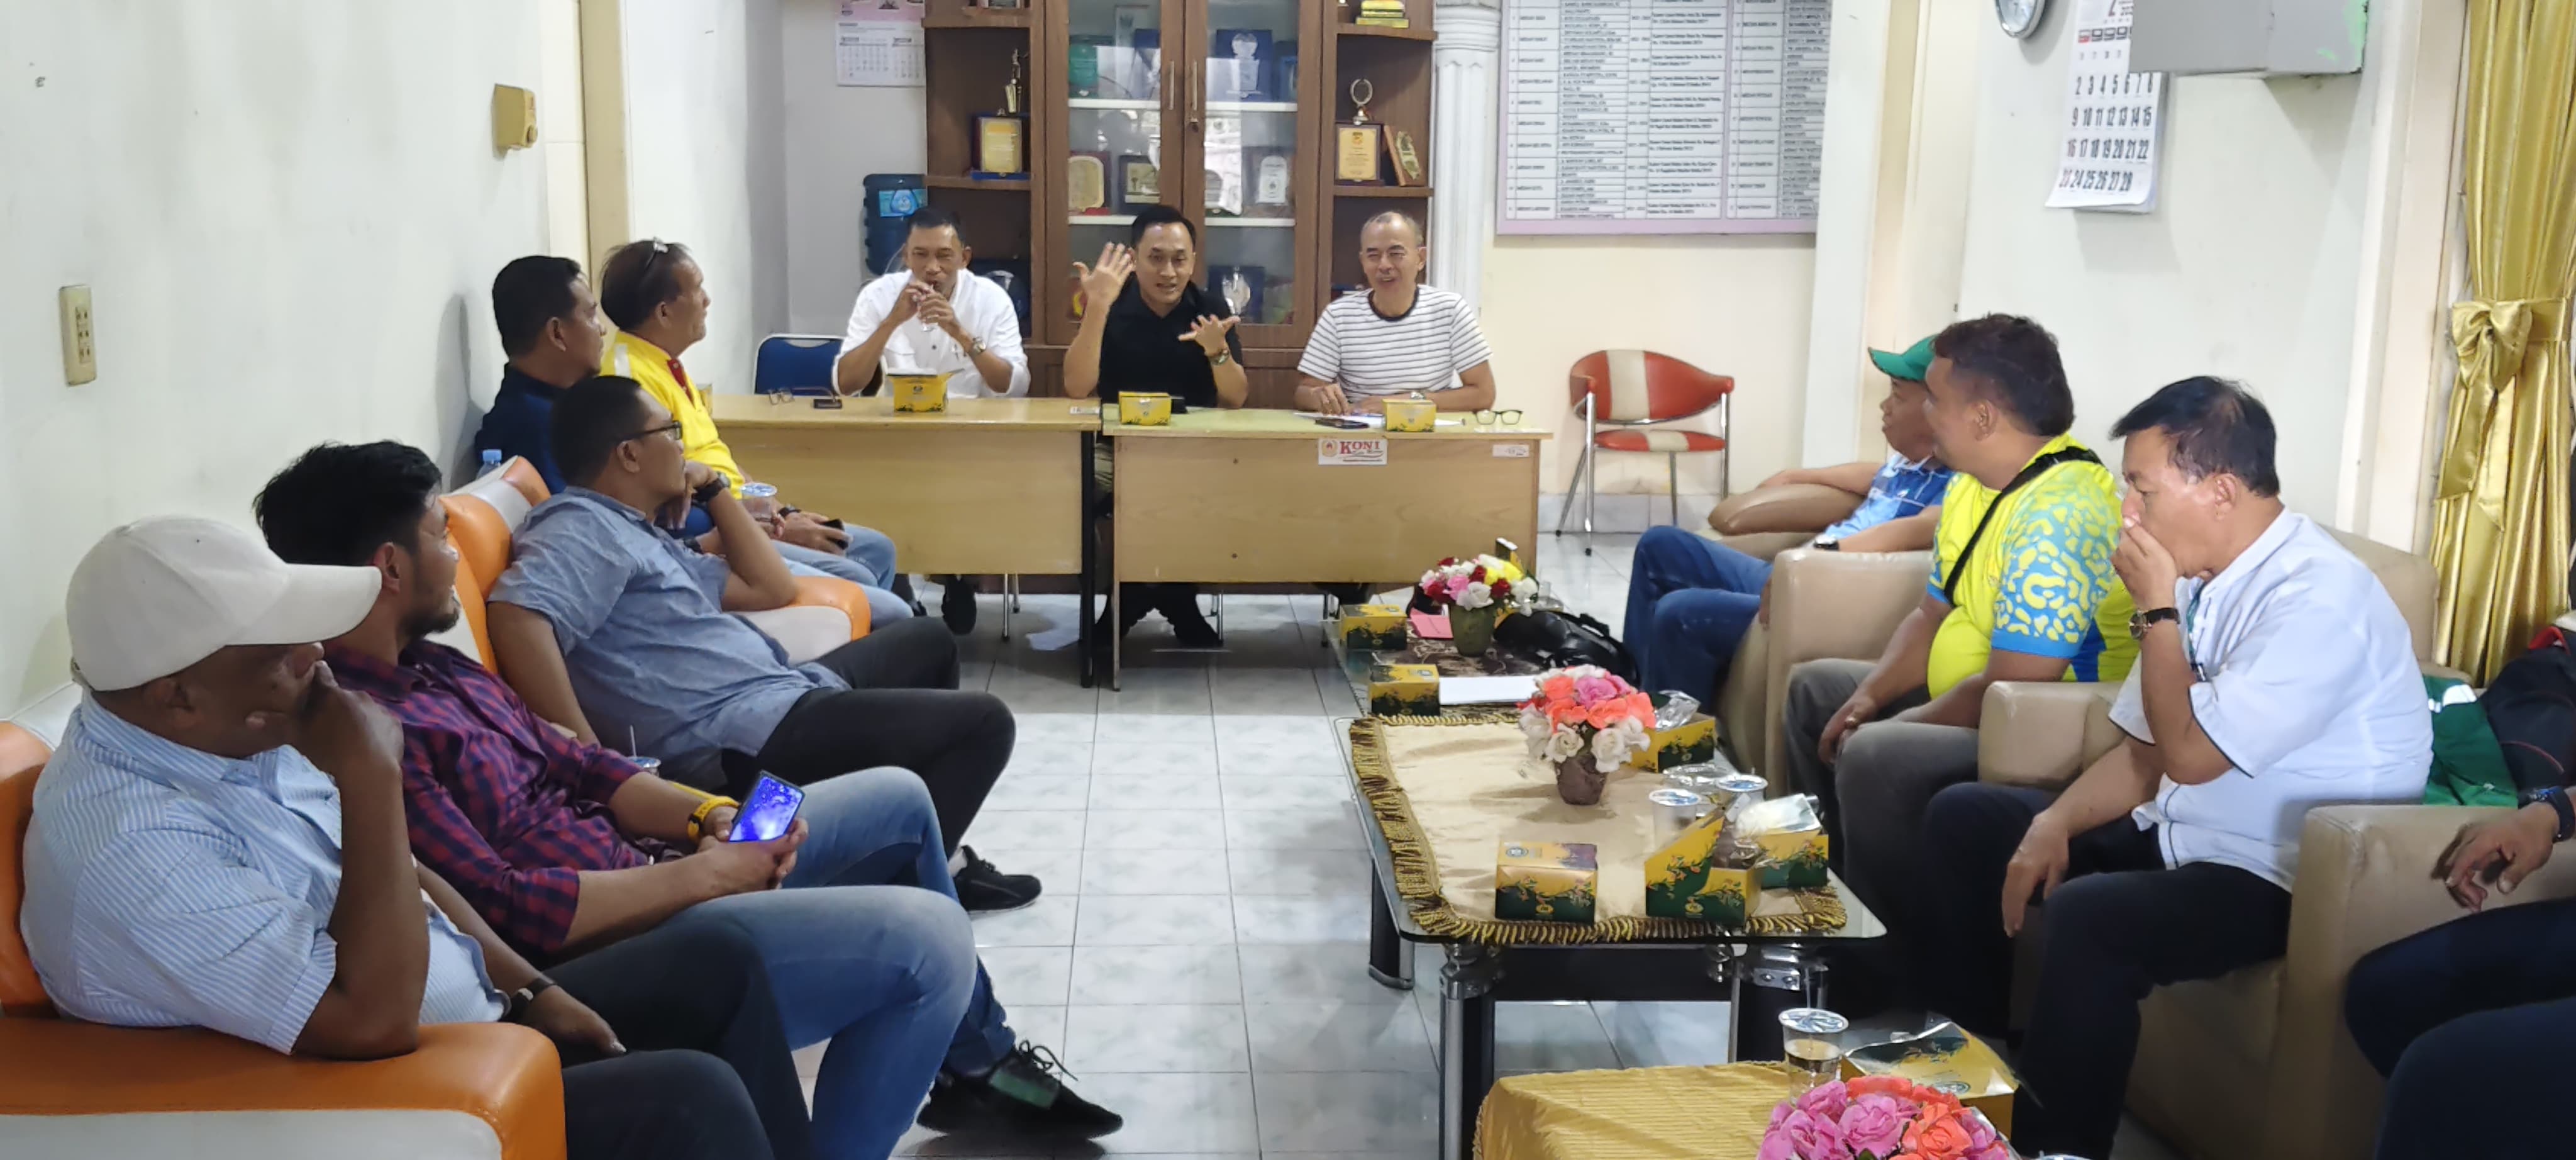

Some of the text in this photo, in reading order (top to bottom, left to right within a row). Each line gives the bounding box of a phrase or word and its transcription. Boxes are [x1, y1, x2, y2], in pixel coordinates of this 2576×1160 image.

[2075, 76, 2082, 95] 2
[2088, 75, 2094, 95] 3
[2100, 75, 2106, 94] 4
[2112, 74, 2118, 94] 5
[2124, 74, 2130, 94] 6
[2072, 106, 2152, 126] 9 10 11 12 13 14 15
[2067, 138, 2149, 159] 16 17 18 19 20 21 22
[2070, 169, 2084, 188] 24
[2082, 170, 2096, 189] 25
[2094, 170, 2108, 190] 26
[2107, 171, 2121, 191] 27
[2119, 171, 2133, 191] 28
[1340, 441, 1380, 454] KONI
